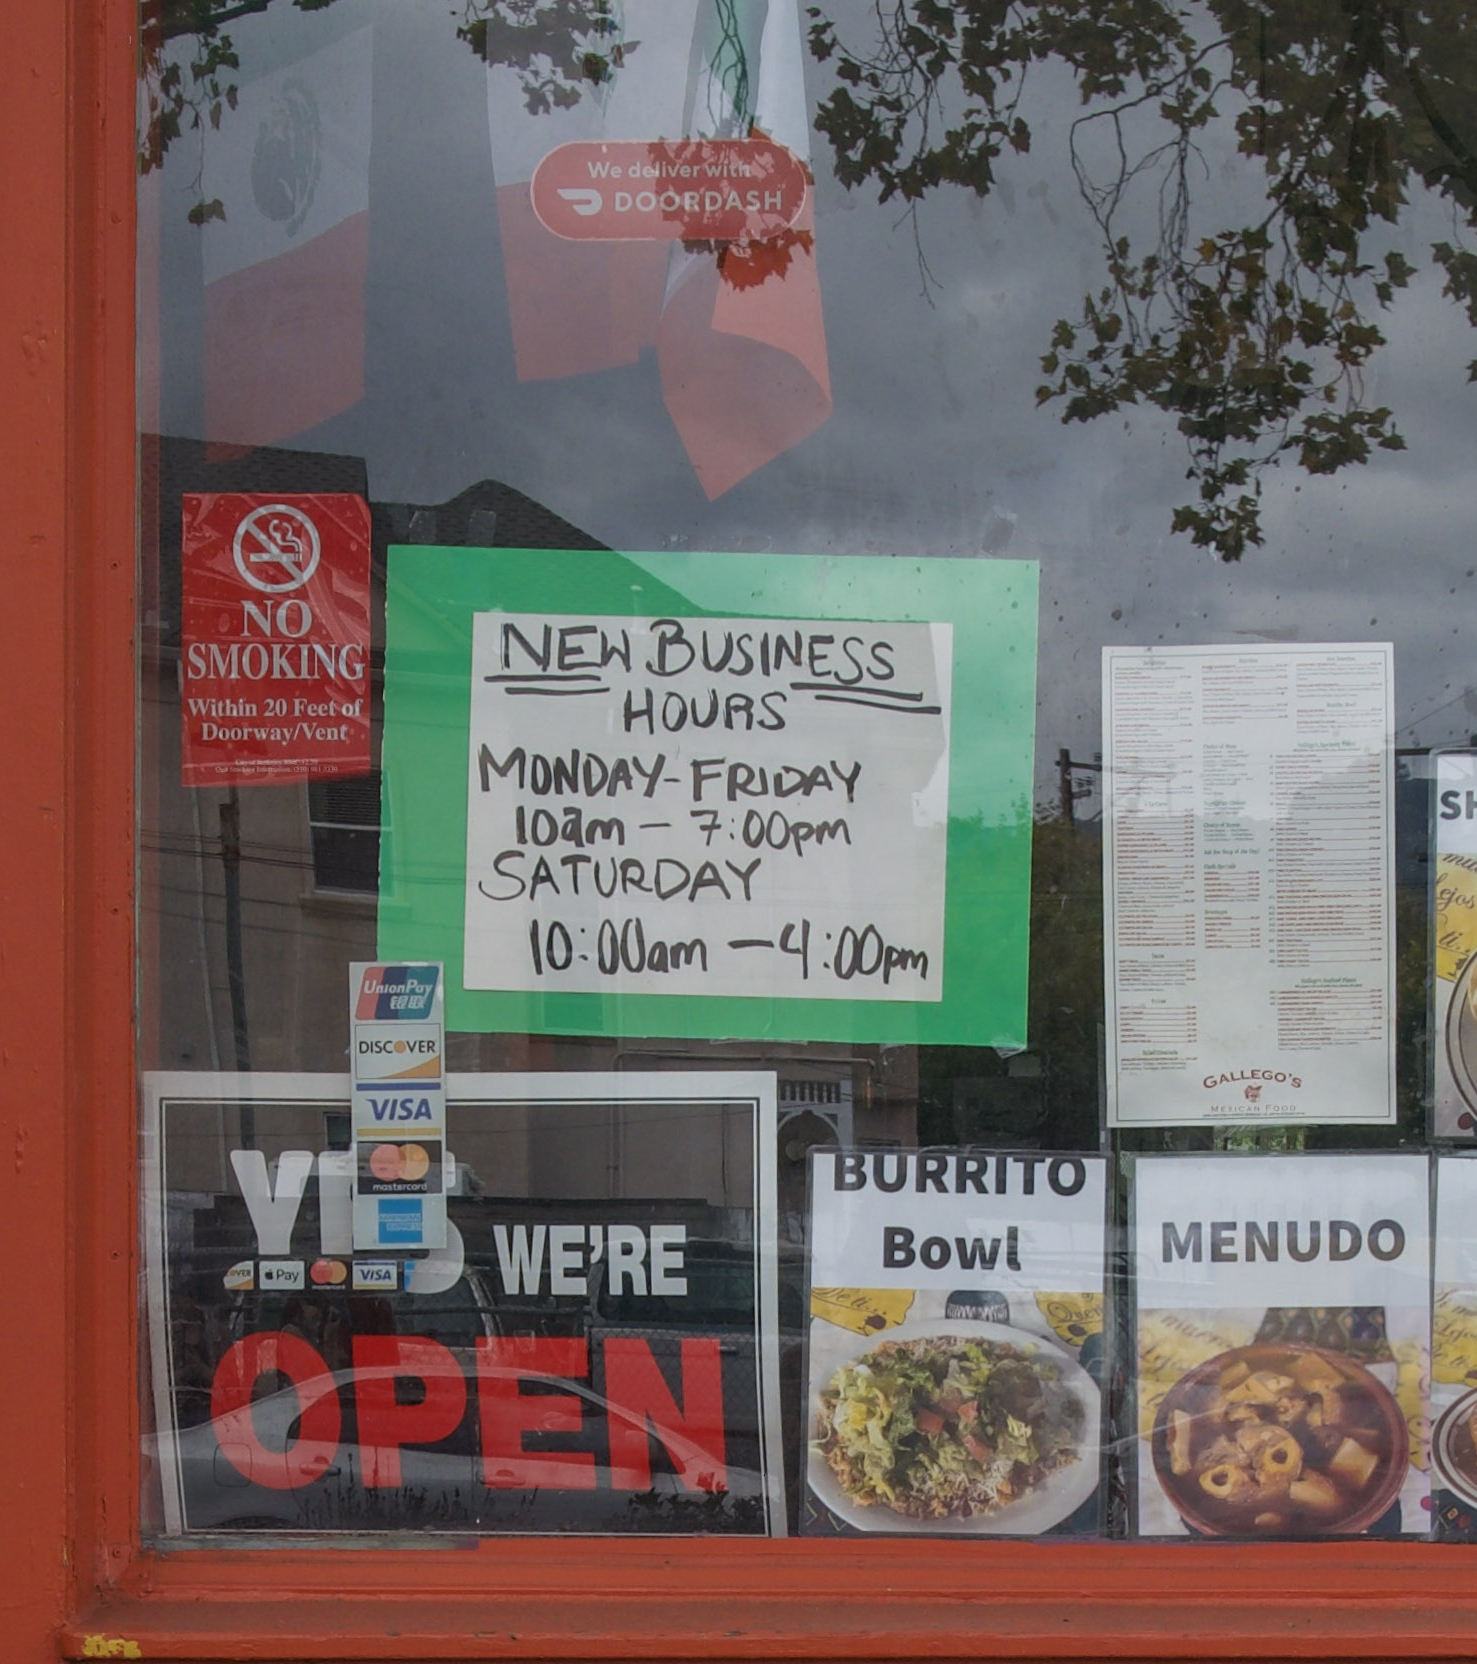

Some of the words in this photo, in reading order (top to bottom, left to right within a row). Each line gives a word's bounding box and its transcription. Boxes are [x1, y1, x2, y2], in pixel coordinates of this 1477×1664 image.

[587, 161, 622, 178] We
[628, 161, 701, 178] deliver
[705, 160, 752, 178] with
[615, 190, 783, 212] DOORDASH
[240, 599, 313, 638] NO
[187, 643, 366, 680] SMOKING
[502, 623, 632, 674] NEW
[645, 618, 896, 684] BUSINESS
[188, 698, 257, 717] Within
[264, 698, 287, 717] 20
[293, 698, 335, 717] Feet
[341, 698, 364, 717] of
[624, 691, 786, 735] HOURS
[201, 722, 348, 746] Doorway/Vent
[515, 808, 626, 848] 10am
[690, 808, 853, 856] 7:00pm
[478, 852, 762, 903] SATURDAY
[529, 919, 708, 975] 10:00am
[364, 979, 434, 998] UnionPay
[358, 1039, 436, 1054] DISCOVER
[1203, 1069, 1302, 1088] GALLEGO'S
[365, 1098, 432, 1121] VISA
[372, 1183, 428, 1191] mastercard
[833, 1153, 1087, 1197] BURRITO
[882, 1224, 1023, 1271] Bowl
[1161, 1218, 1407, 1264] MENUDO
[276, 1269, 299, 1283] Pay
[359, 1269, 392, 1281] VISA
[492, 1224, 688, 1296] WE'RE
[210, 1330, 729, 1492] OPEN
